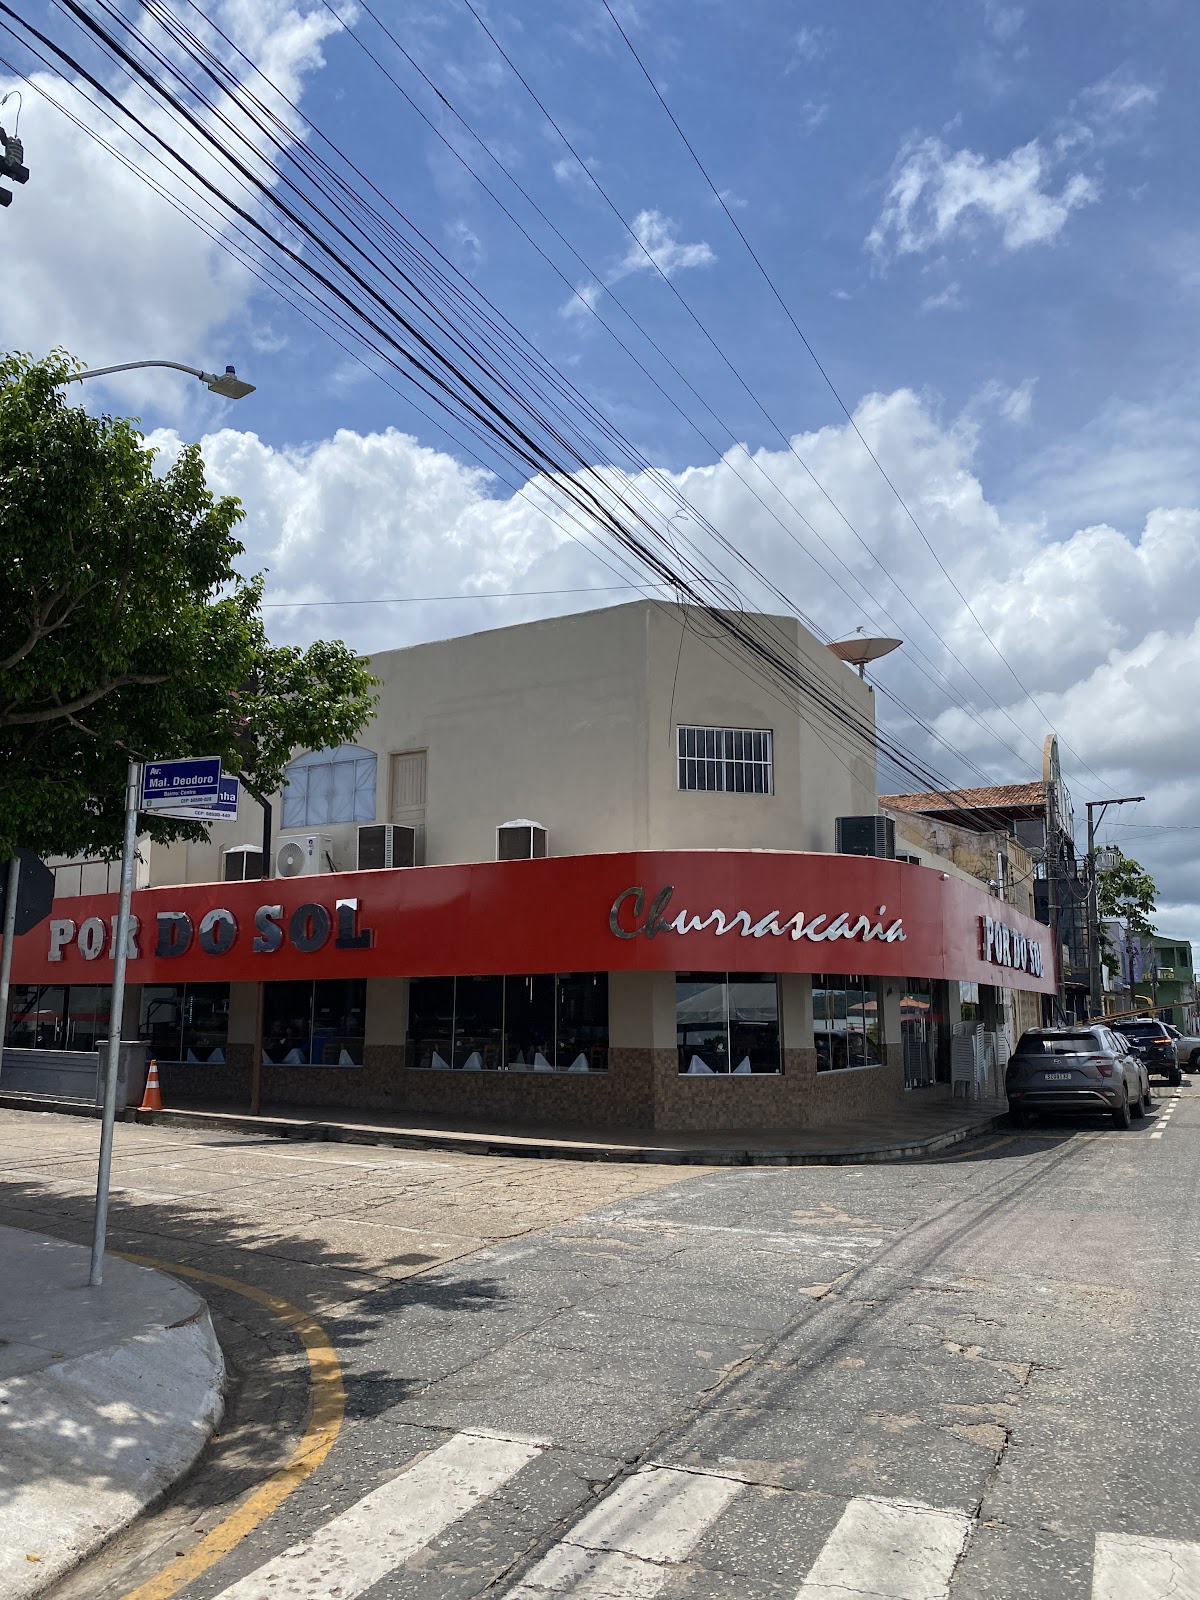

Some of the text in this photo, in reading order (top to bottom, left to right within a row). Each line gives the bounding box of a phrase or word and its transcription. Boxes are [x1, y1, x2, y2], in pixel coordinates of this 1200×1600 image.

[149, 776, 214, 788] Mal. Deodoro
[47, 897, 375, 962] POR DO SOL
[609, 885, 908, 943] Churrascaria
[983, 915, 1045, 978] POR DO SOL
